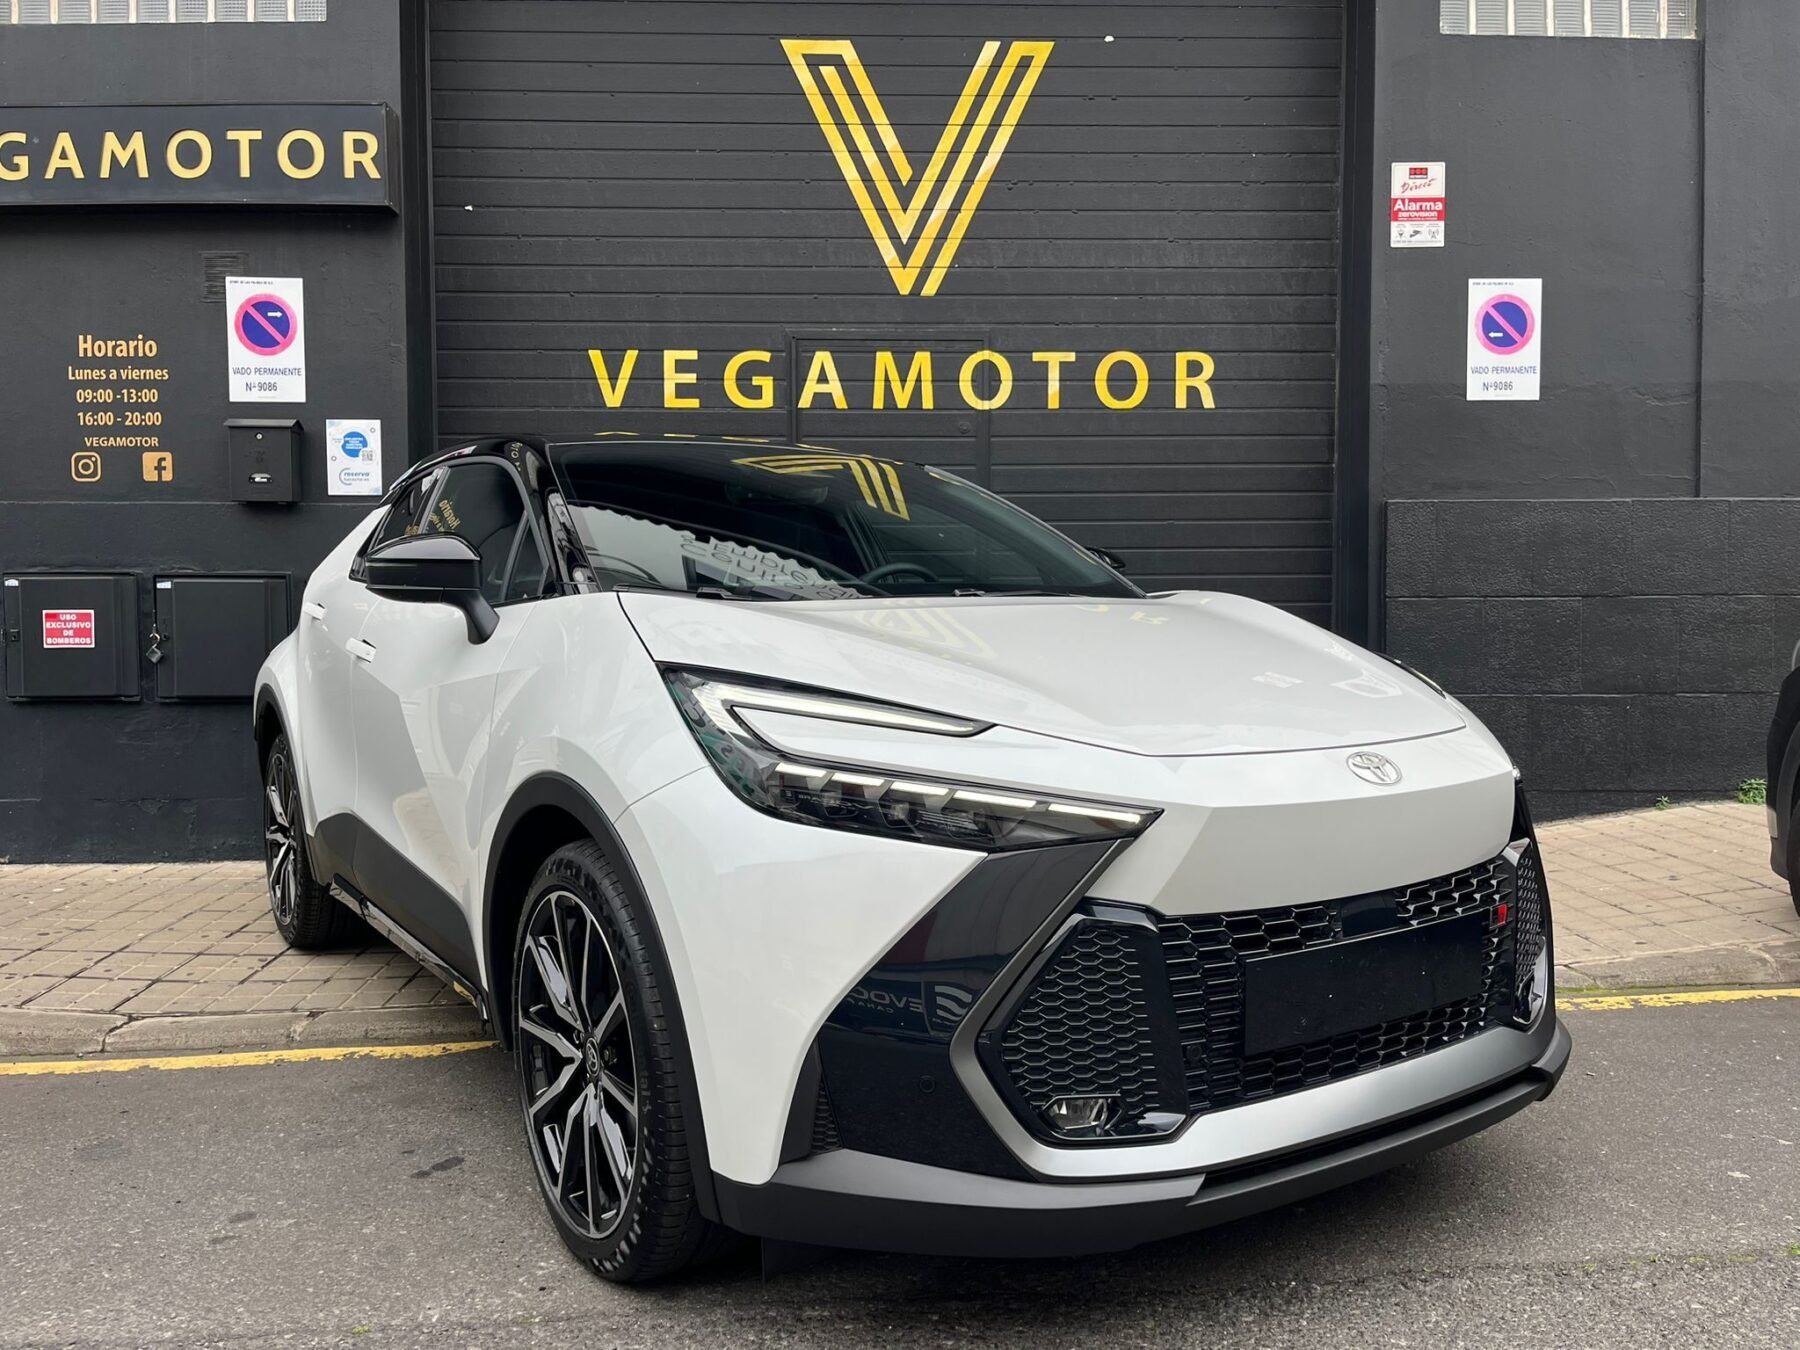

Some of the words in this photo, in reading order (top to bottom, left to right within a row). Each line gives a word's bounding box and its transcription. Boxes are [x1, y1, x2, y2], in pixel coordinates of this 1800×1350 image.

[1393, 198, 1443, 211] Alarma
[78, 334, 158, 358] Horario
[68, 365, 106, 380] Lunes
[109, 368, 117, 380] a
[119, 365, 169, 380] viernes
[232, 367, 252, 376] VADO
[254, 367, 302, 377] PERMANENTE
[1470, 366, 1490, 375] VADO
[1491, 366, 1538, 375] PERMANENTE
[588, 349, 1216, 411] VEGAMOTOR
[76, 388, 114, 403] 09:00
[77, 411, 114, 426] 16:00
[124, 411, 162, 426] 20:00
[84, 436, 159, 447] VEGAMOTOR
[60, 613, 77, 621] USO
[46, 621, 91, 629] EXCLUSIVO
[63, 629, 74, 637] DE
[47, 637, 91, 645] BOMBEROS
